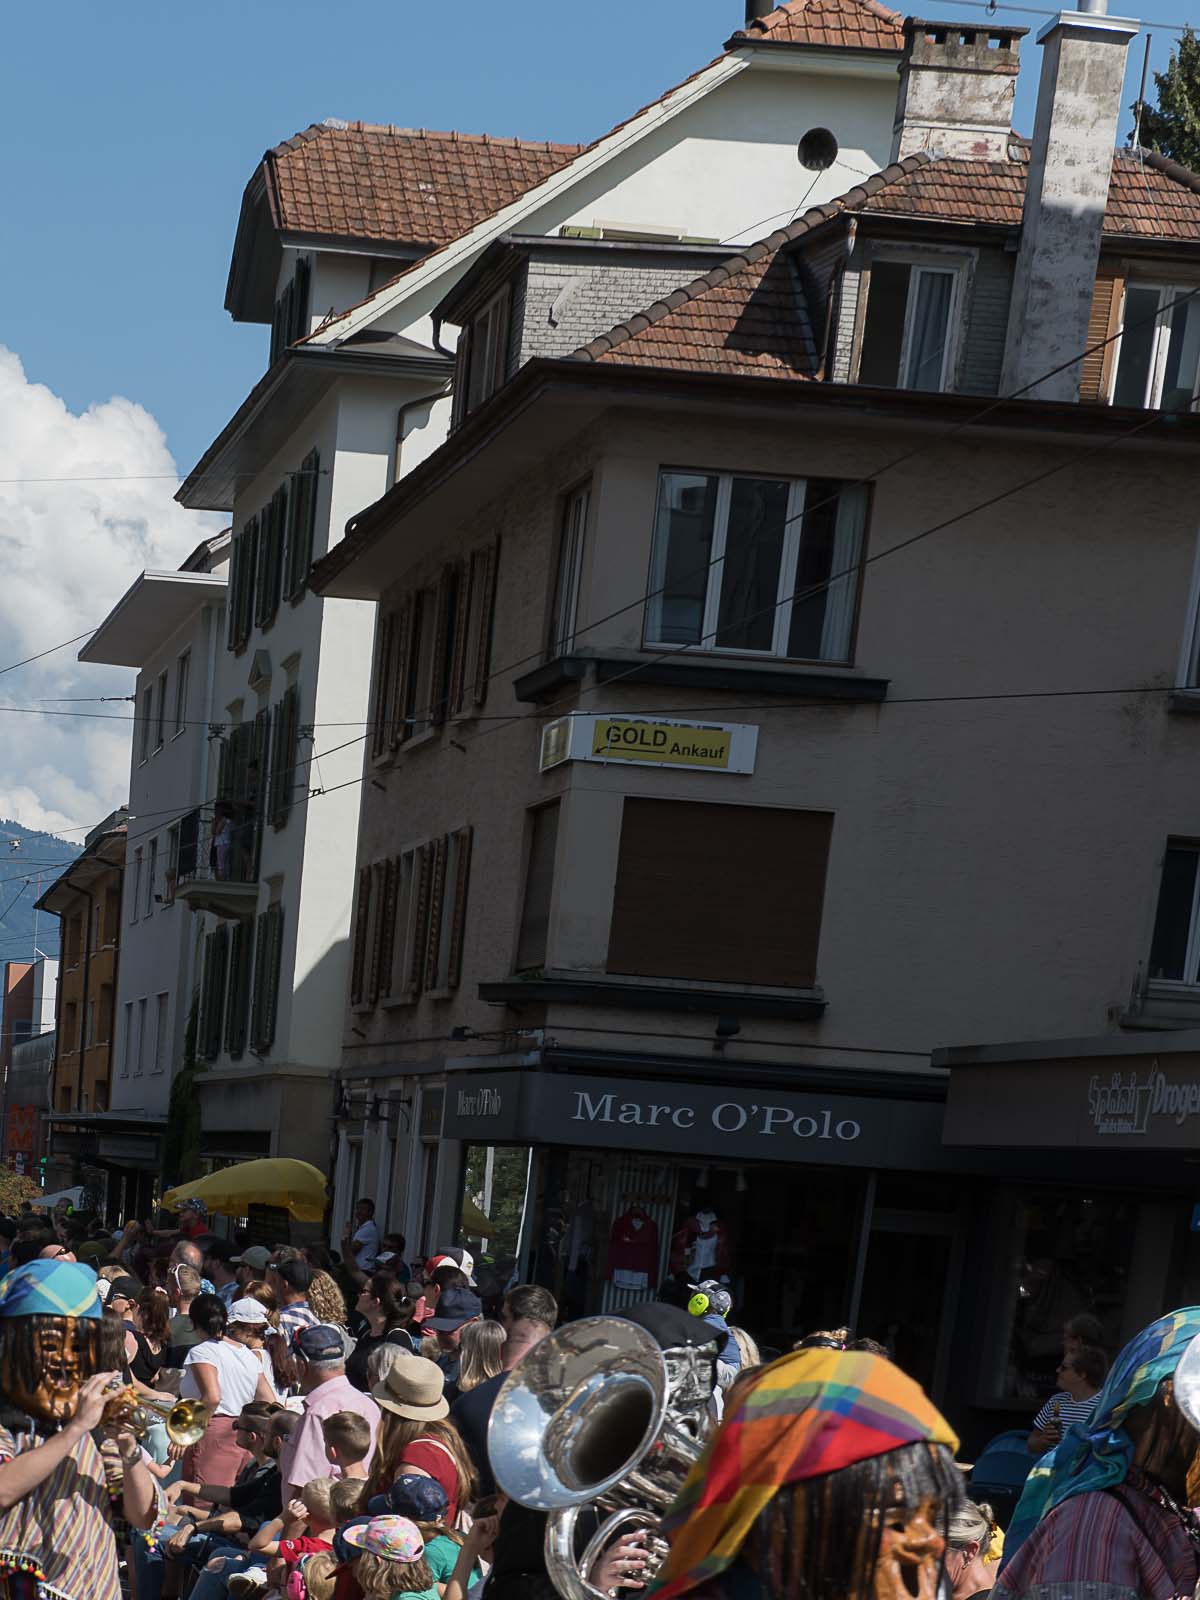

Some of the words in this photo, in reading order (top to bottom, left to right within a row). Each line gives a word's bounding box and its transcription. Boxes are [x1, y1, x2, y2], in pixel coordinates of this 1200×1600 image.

[606, 726, 667, 747] GOLD
[669, 742, 725, 759] Ankauf
[570, 1091, 695, 1128] Marc
[711, 1103, 861, 1141] O'Polo
